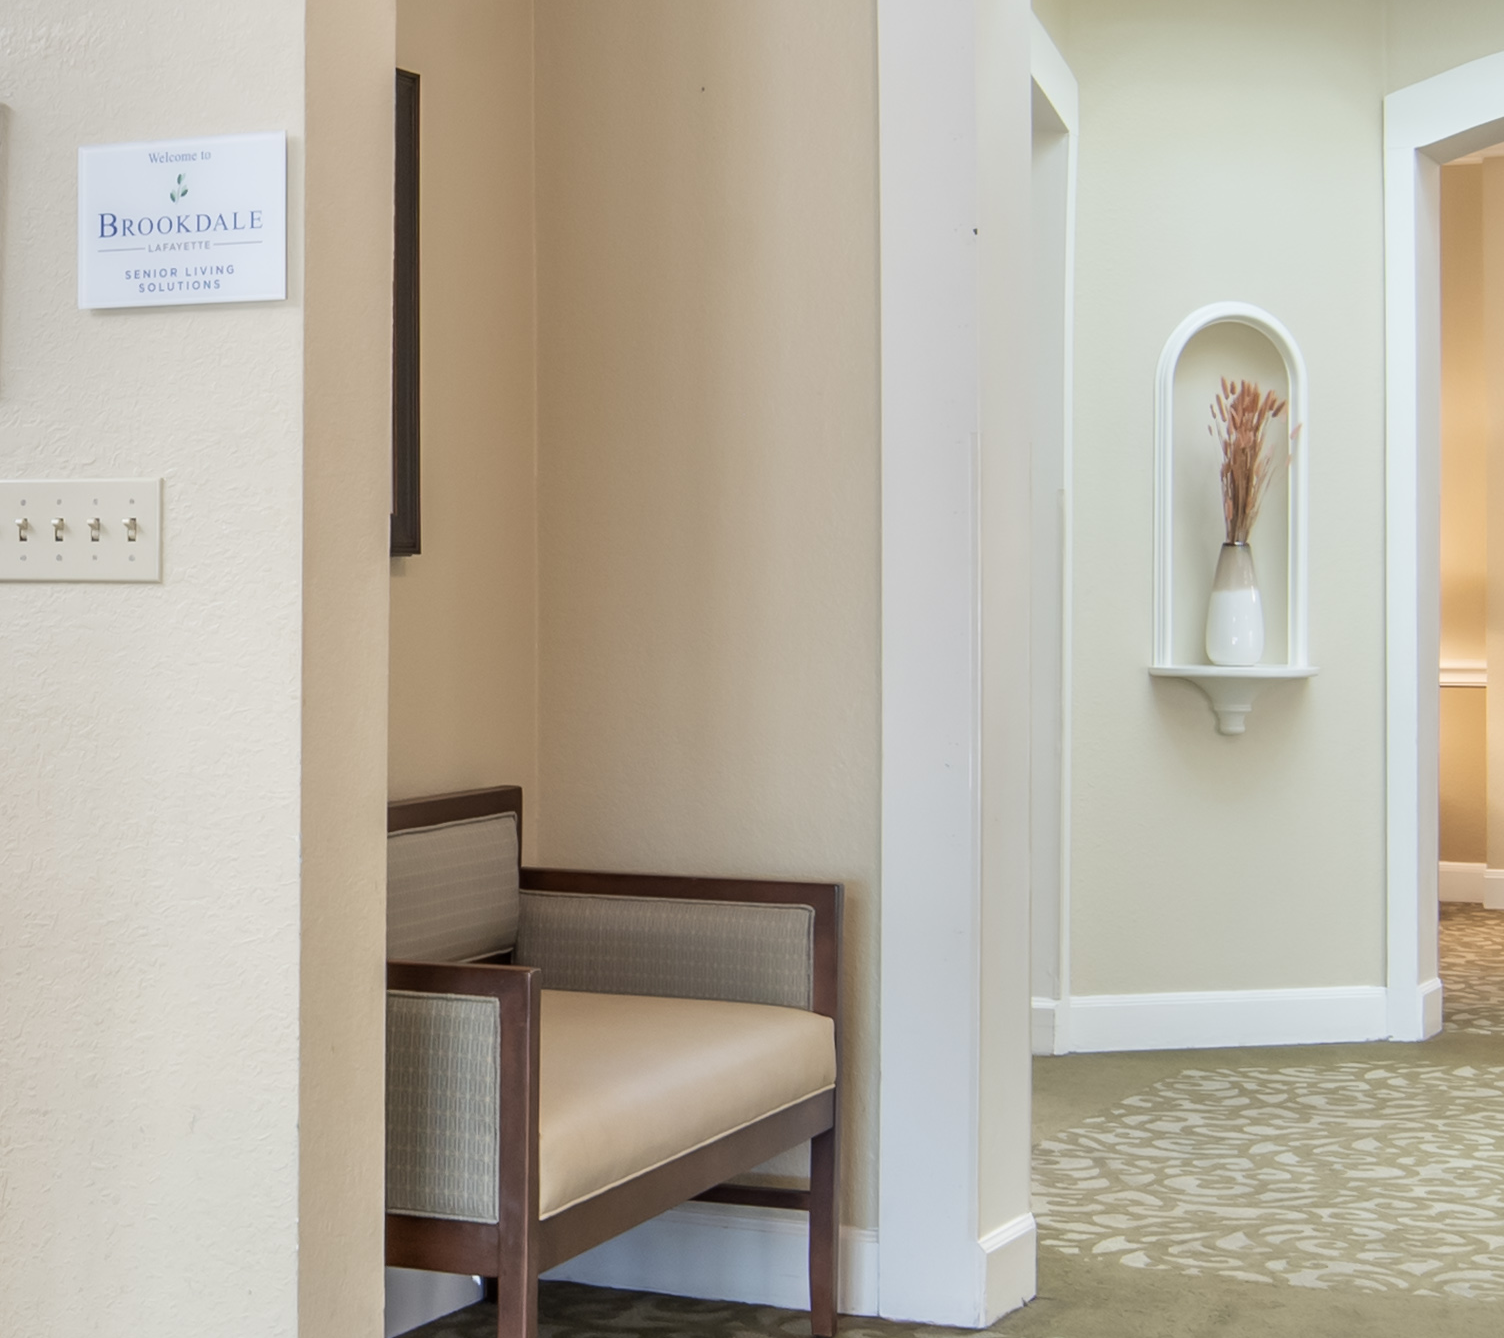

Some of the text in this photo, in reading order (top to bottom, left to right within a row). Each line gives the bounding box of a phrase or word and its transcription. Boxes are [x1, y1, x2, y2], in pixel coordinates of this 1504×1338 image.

[148, 151, 211, 164] Welcome to
[98, 210, 264, 239] BROOKDALE
[148, 240, 211, 253] LAFAYETTE
[125, 264, 235, 280] SENIOR LIVING
[138, 279, 221, 293] SOLUTIONS
